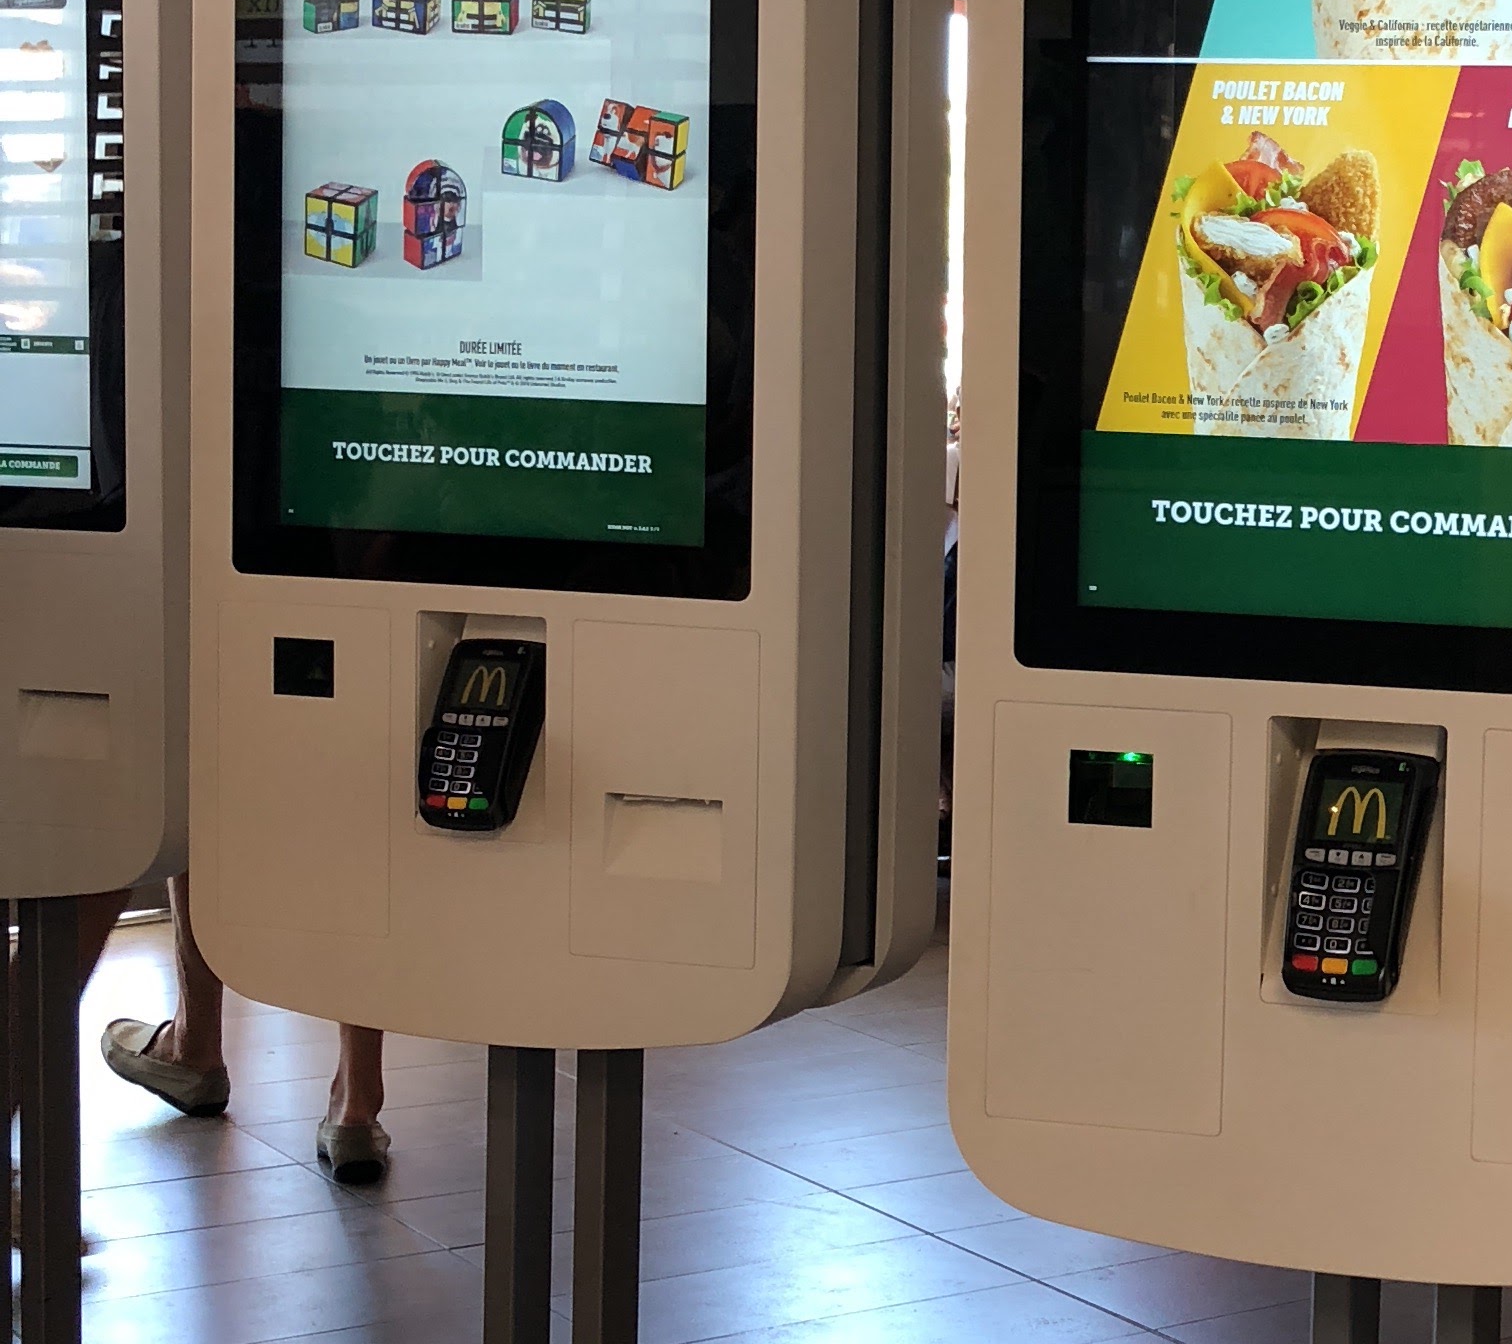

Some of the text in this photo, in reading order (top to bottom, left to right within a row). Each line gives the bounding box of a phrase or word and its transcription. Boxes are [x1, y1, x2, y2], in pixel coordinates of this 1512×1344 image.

[1339, 19, 1367, 34] Veggie
[1369, 19, 1376, 31] &
[1377, 19, 1419, 31] California
[1426, 20, 1458, 31] recette
[1375, 35, 1479, 48] inspirée de la Californie.
[1212, 80, 1345, 102] POULET BACON
[1221, 105, 1331, 127] & NEW YORK
[459, 339, 522, 356] DURÉE LIMITÉE
[1123, 392, 1149, 403] Poulet
[1151, 393, 1177, 404] Bacon
[1178, 394, 1185, 404] &
[1187, 394, 1204, 405] New
[1206, 395, 1224, 406] York
[1231, 396, 1260, 408] recette
[1298, 397, 1308, 409] de
[1310, 398, 1328, 411] New
[1329, 398, 1348, 411] York
[1161, 410, 1180, 419] avec
[1182, 411, 1196, 420] une
[1199, 409, 1239, 423] spécialité
[1267, 414, 1278, 423] au
[1279, 414, 1308, 426] poulet.
[8, 460, 60, 471] COMMANDE
[333, 441, 653, 474] TOUCHEZ POUR COMMANDER
[1151, 499, 1293, 529] TOUCHEZ
[1300, 506, 1383, 534] POUR
